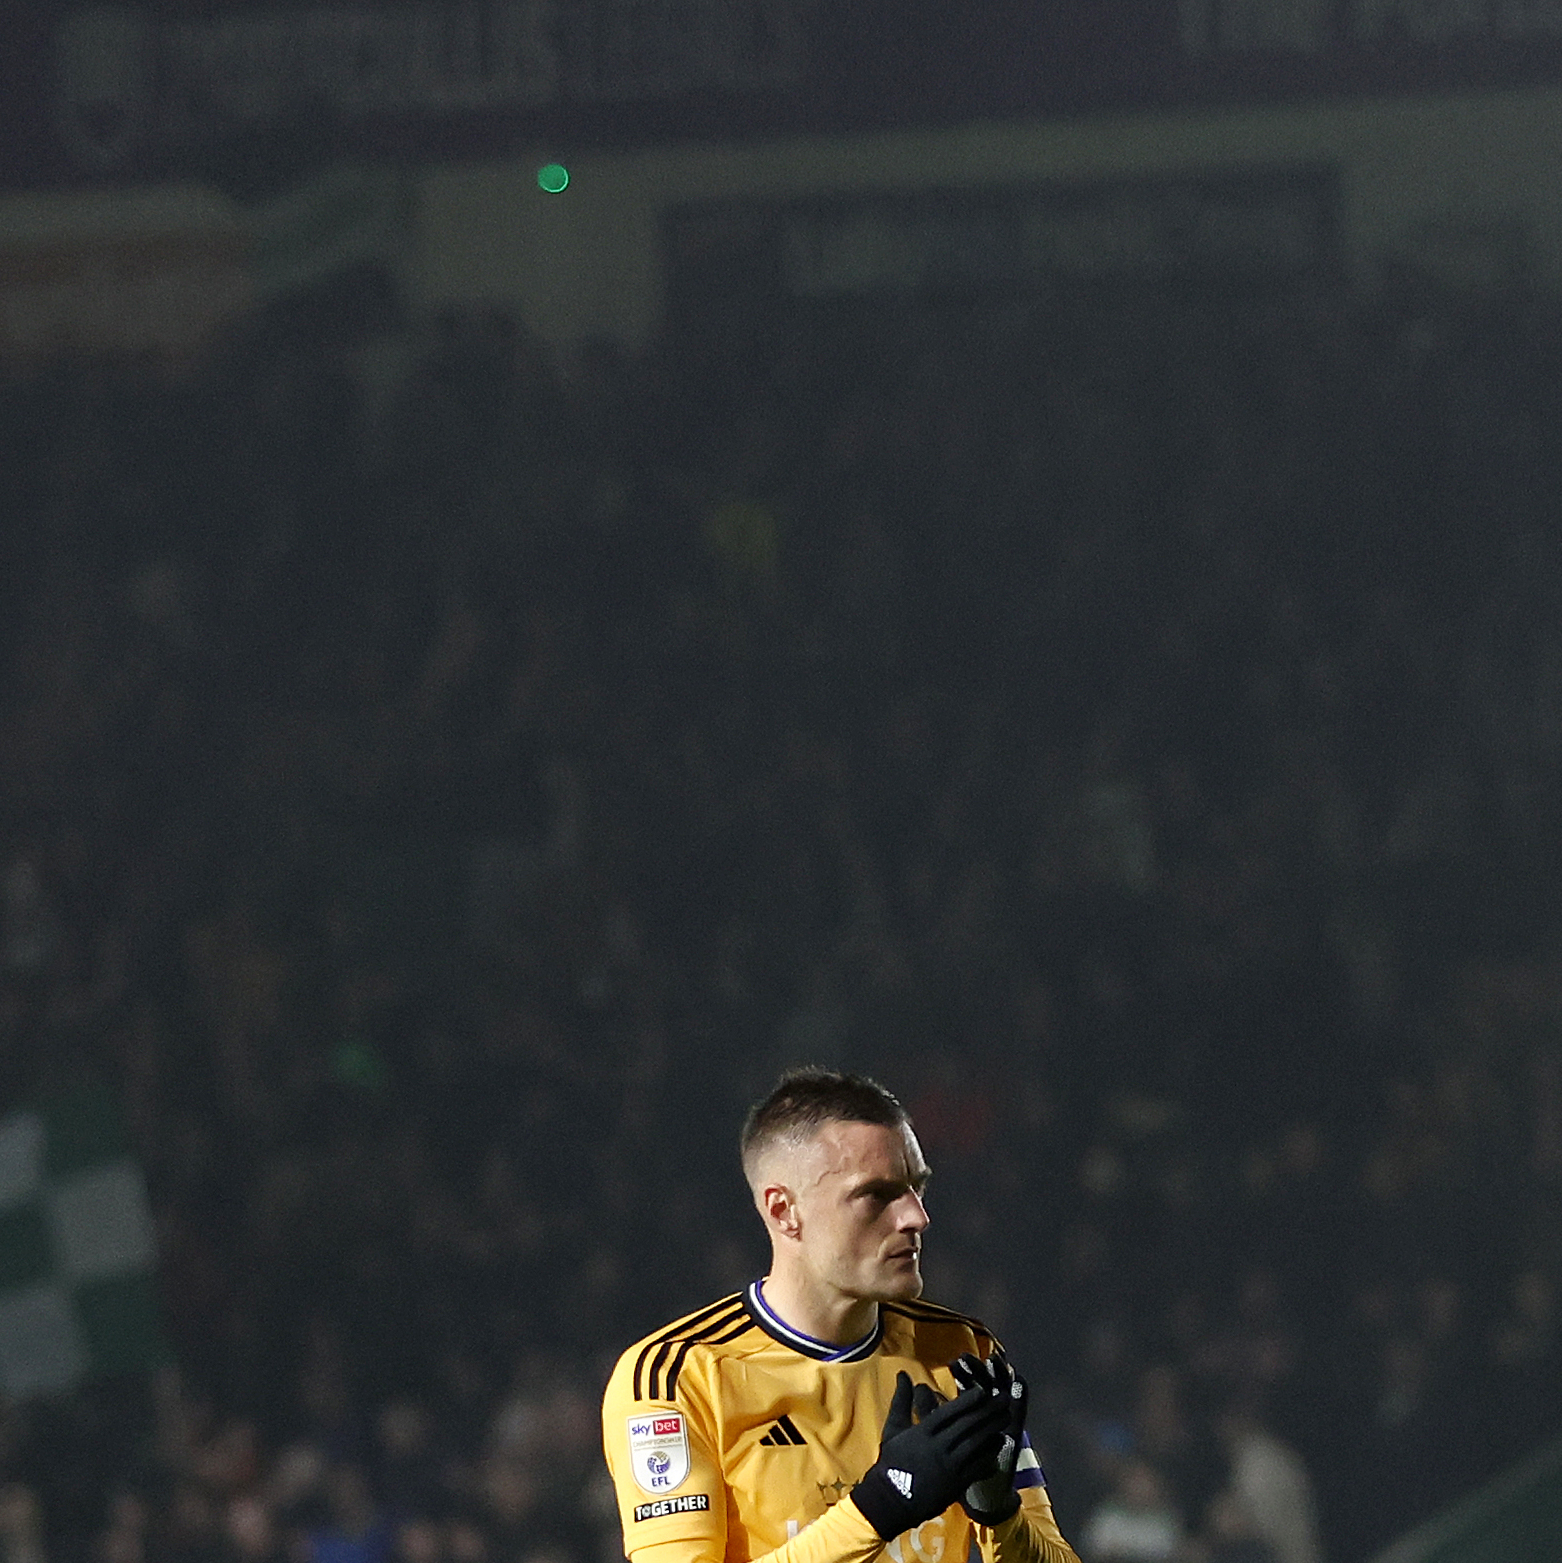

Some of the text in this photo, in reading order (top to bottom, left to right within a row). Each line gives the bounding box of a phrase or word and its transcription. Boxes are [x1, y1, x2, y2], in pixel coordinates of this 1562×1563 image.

[632, 1420, 678, 1436] sky bet
[651, 1476, 670, 1487] EFL
[636, 1496, 707, 1521] TOGETHER
